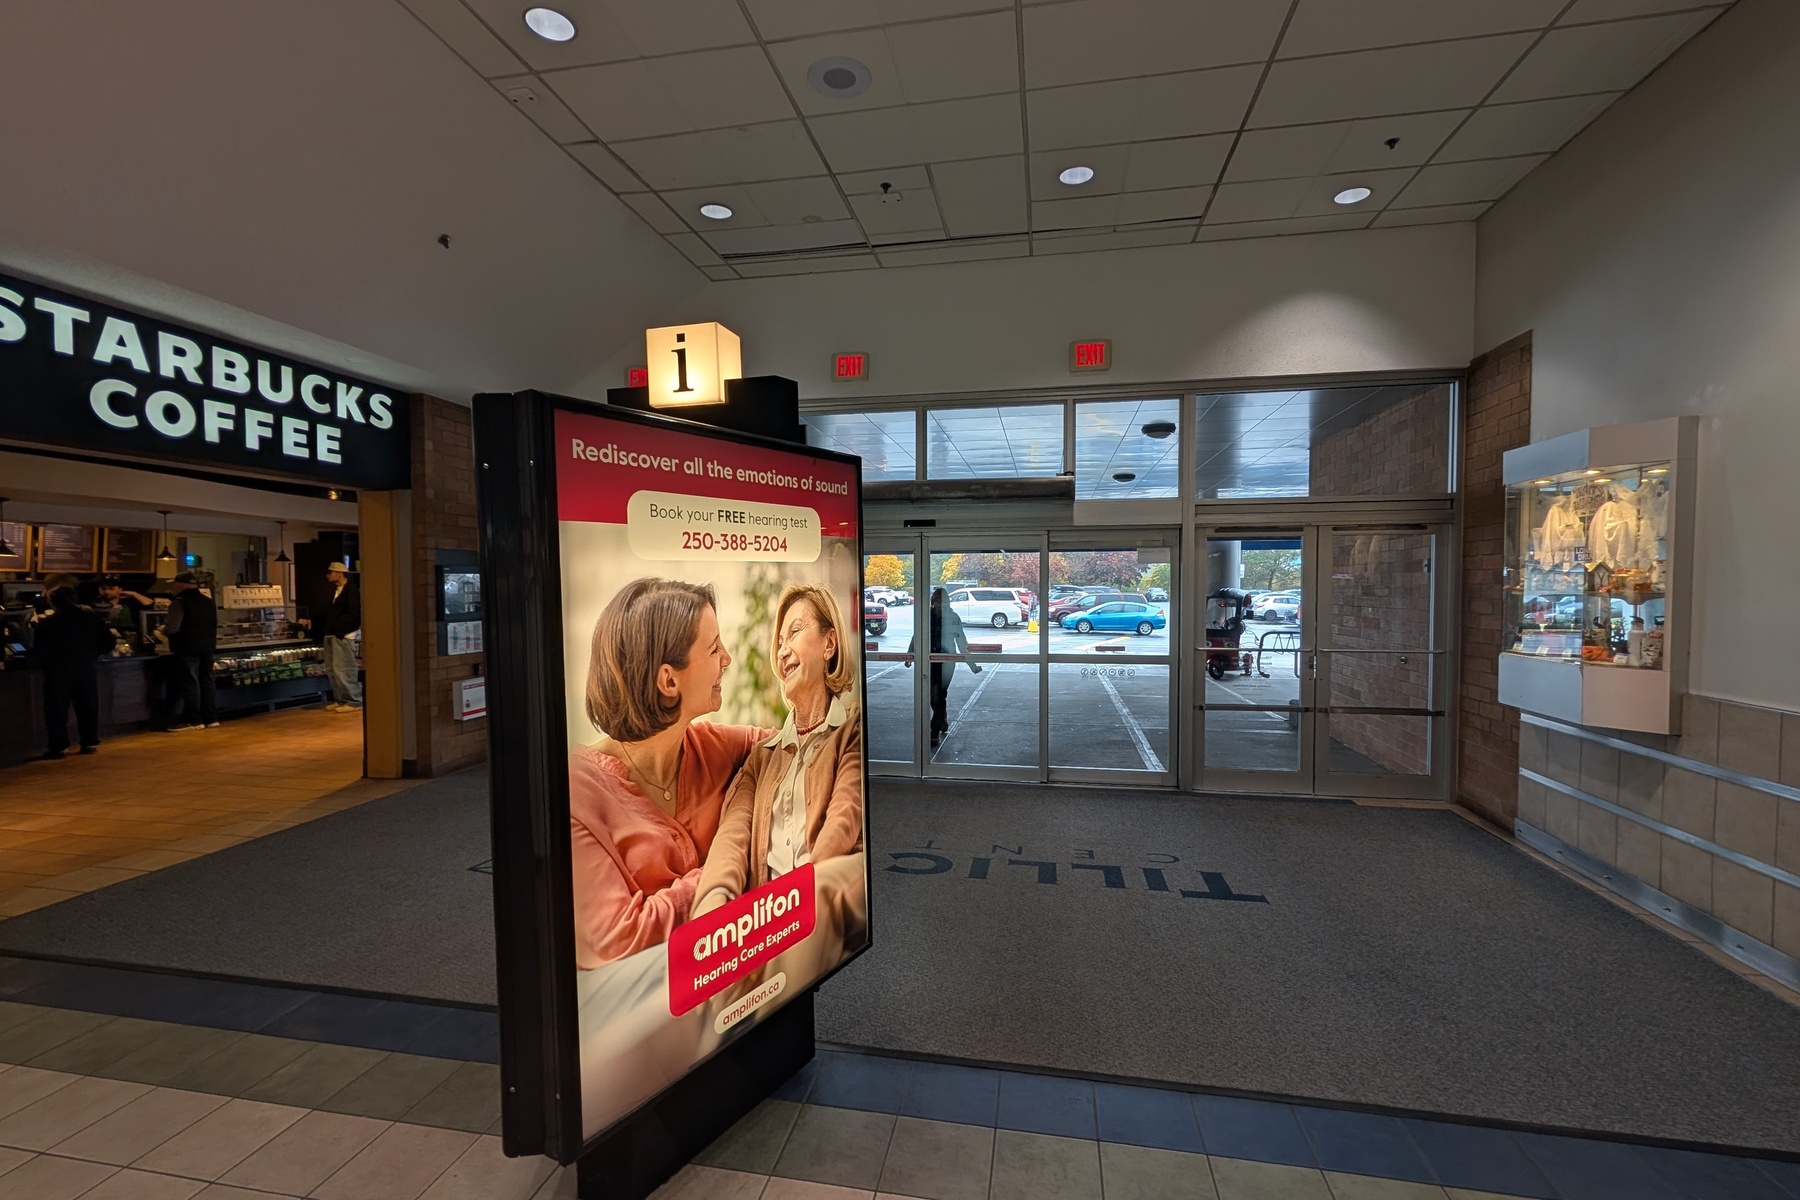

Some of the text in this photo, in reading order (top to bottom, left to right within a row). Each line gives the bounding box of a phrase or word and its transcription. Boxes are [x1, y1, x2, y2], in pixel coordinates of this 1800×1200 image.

[0, 287, 394, 430] STARBUCKS
[837, 355, 863, 378] EXIT
[1076, 343, 1105, 365] EXIT
[630, 368, 647, 388] EX
[89, 378, 342, 464] COFFEE
[571, 438, 848, 496] Rediscover all the emotions of sound
[649, 503, 808, 530] Book your FREE hearing test
[682, 531, 788, 552] 250-388-5204
[915, 840, 1180, 864] CENT
[883, 852, 1270, 905] TILLIC
[693, 888, 800, 961] amplifon
[693, 920, 800, 991] Hearing Care Experts
[722, 980, 780, 1025] amplifon.ca
